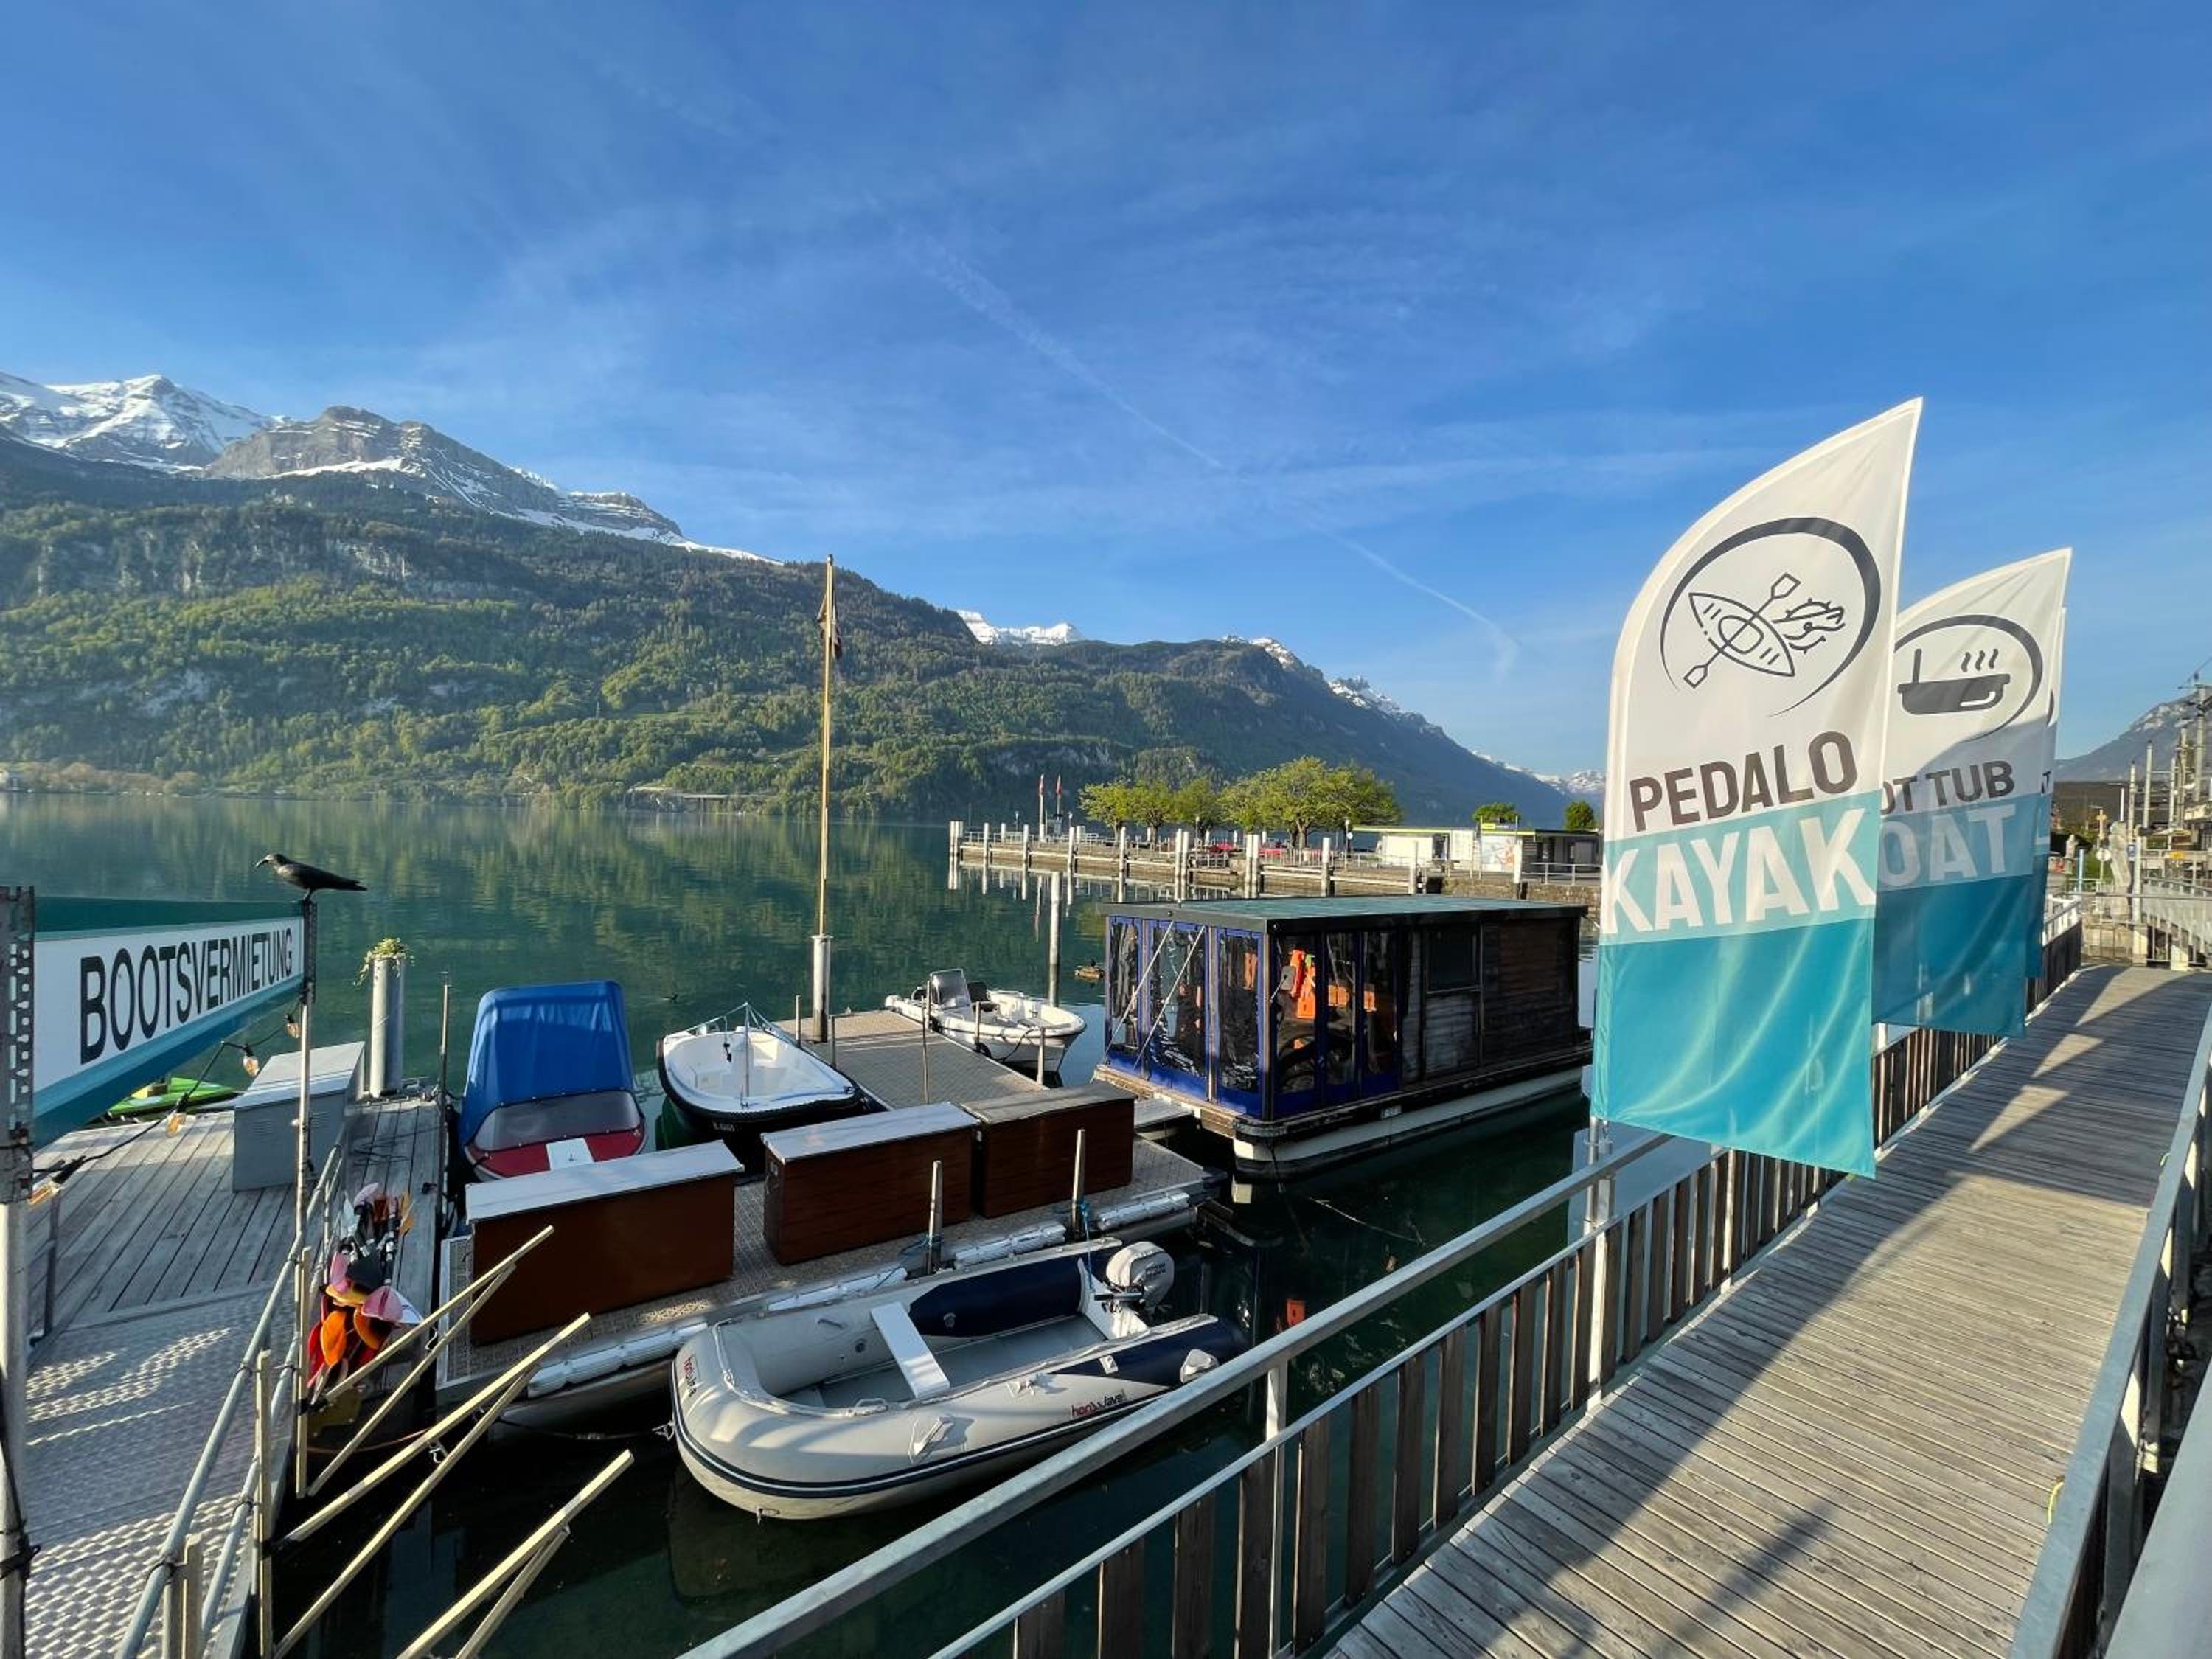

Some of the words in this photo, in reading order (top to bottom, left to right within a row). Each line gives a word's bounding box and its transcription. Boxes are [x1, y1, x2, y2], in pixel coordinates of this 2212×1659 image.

[1629, 730, 1858, 832] PEDALO
[1926, 760, 2015, 807] TUB
[1601, 808, 1876, 935] KAYAK
[80, 928, 293, 1065] BOOTSVERMIETUNG
